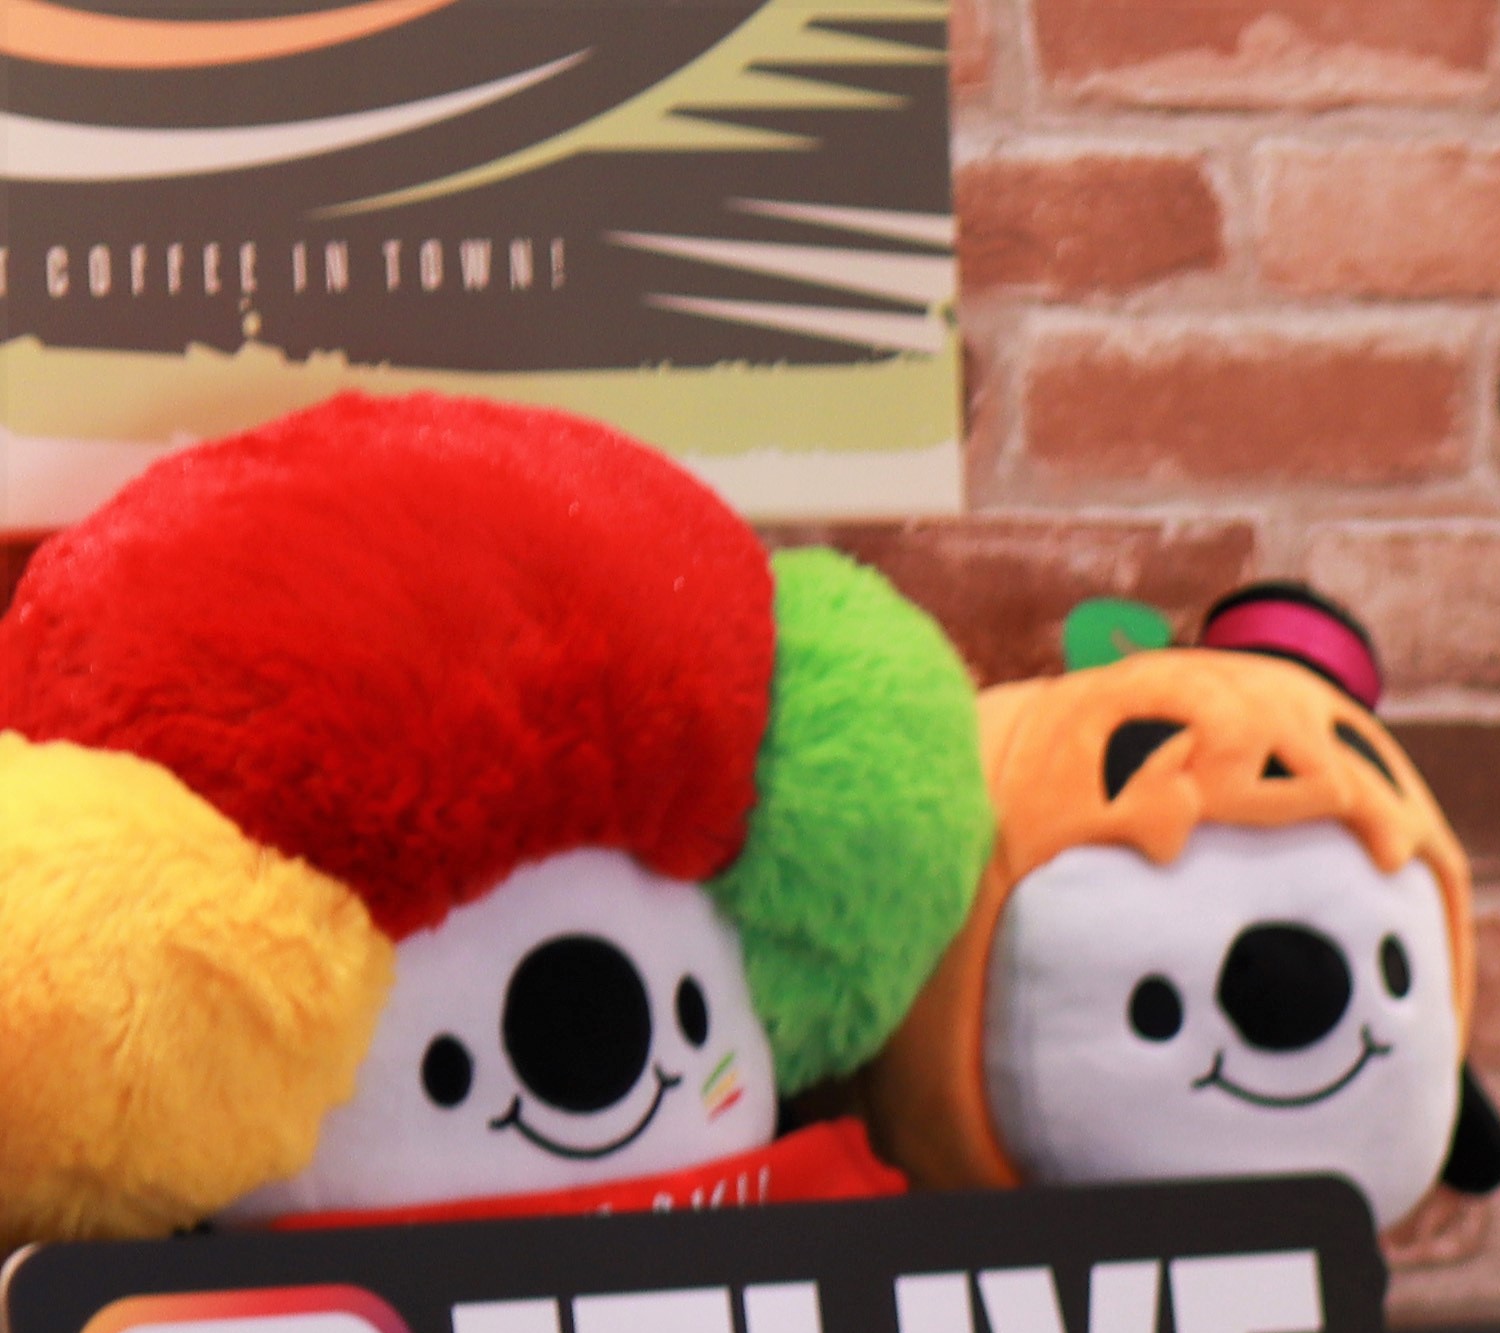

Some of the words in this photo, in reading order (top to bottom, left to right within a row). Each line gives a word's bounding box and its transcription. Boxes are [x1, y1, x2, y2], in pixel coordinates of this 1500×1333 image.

[46, 242, 257, 298] COFFEE
[292, 239, 350, 294] IN
[382, 236, 567, 292] TOWN!
